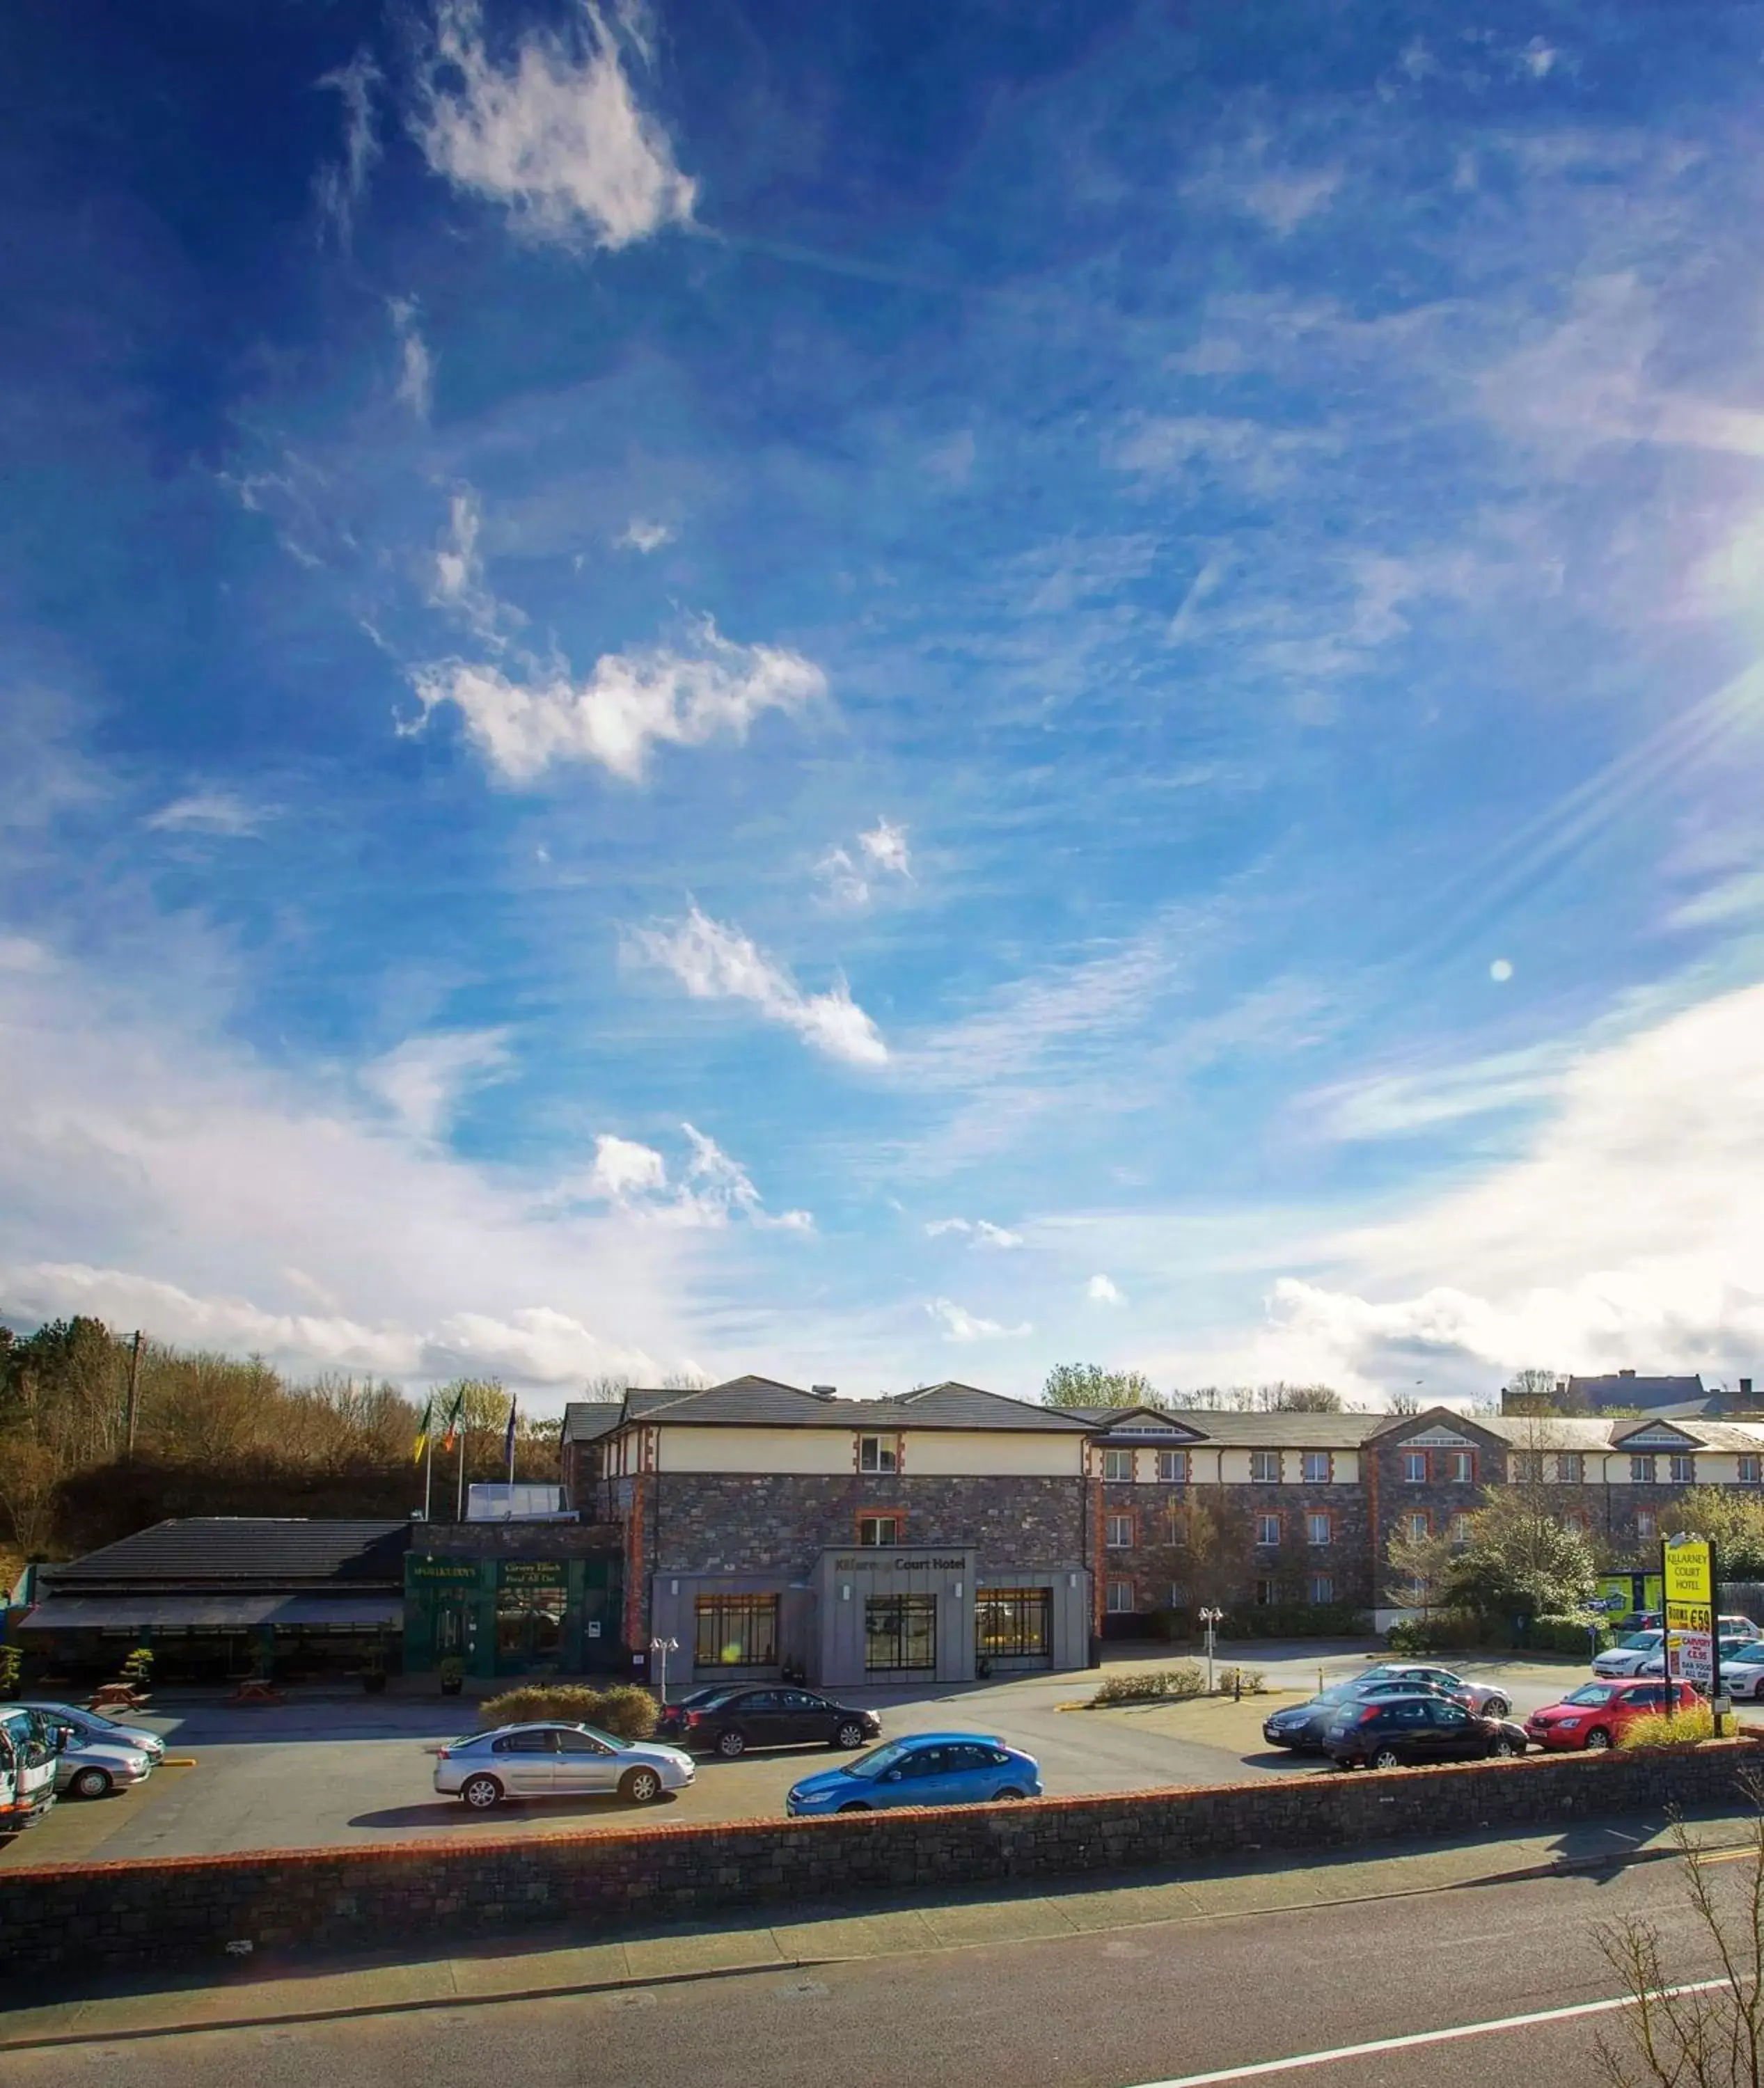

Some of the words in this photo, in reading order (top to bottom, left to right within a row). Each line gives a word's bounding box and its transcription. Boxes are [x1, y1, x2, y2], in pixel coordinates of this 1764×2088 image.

[895, 1558, 930, 1570] Court
[933, 1557, 966, 1570] Hotel
[1667, 1553, 1707, 1565] KILLARNEY
[1675, 1567, 1701, 1576] COURT
[1676, 1580, 1701, 1590] HOTEL
